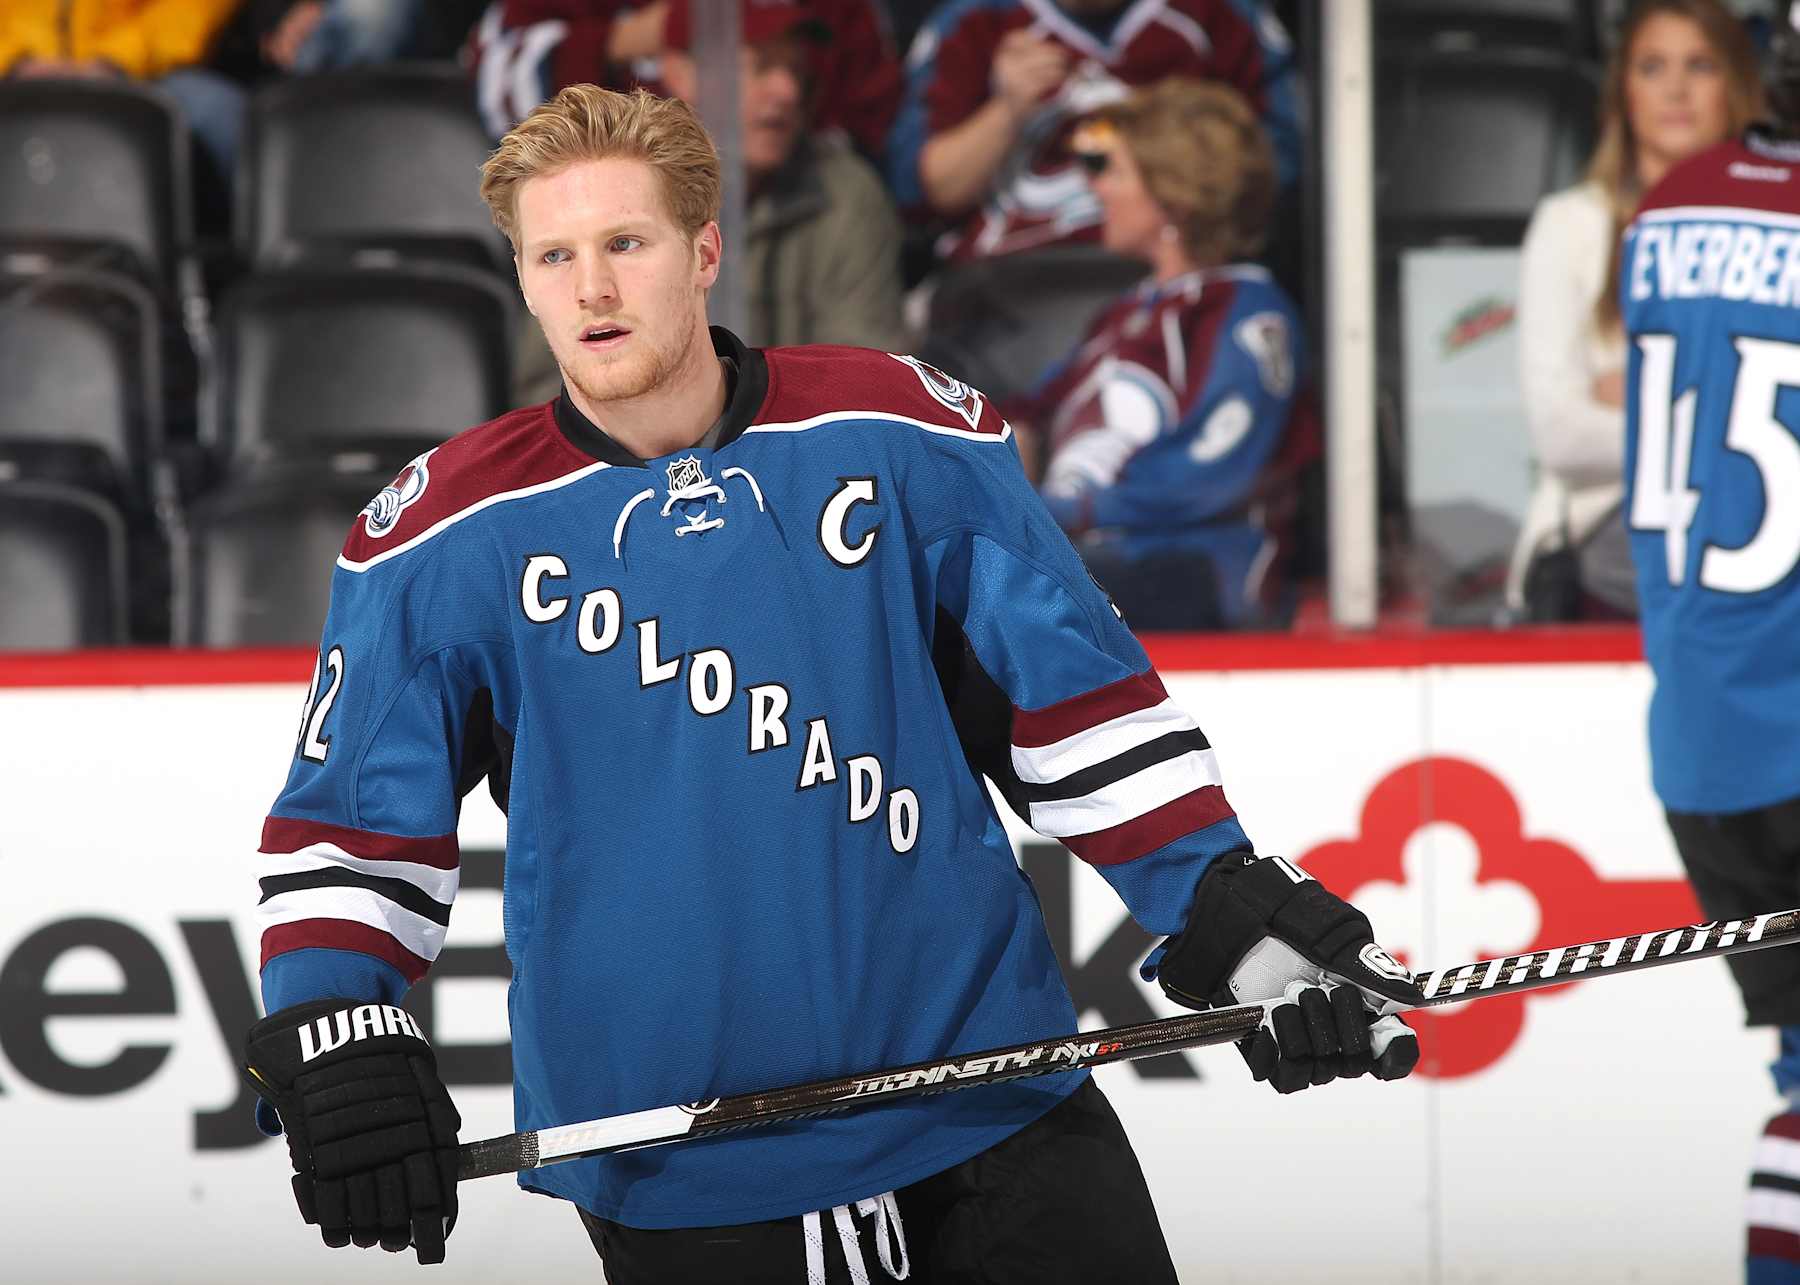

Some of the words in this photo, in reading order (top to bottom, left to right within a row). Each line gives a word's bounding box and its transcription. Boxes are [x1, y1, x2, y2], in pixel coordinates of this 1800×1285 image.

[818, 476, 882, 569] C
[1629, 331, 1800, 595] 45
[520, 552, 922, 855] COLORADO
[836, 1048, 1044, 1101] DYNASTY
